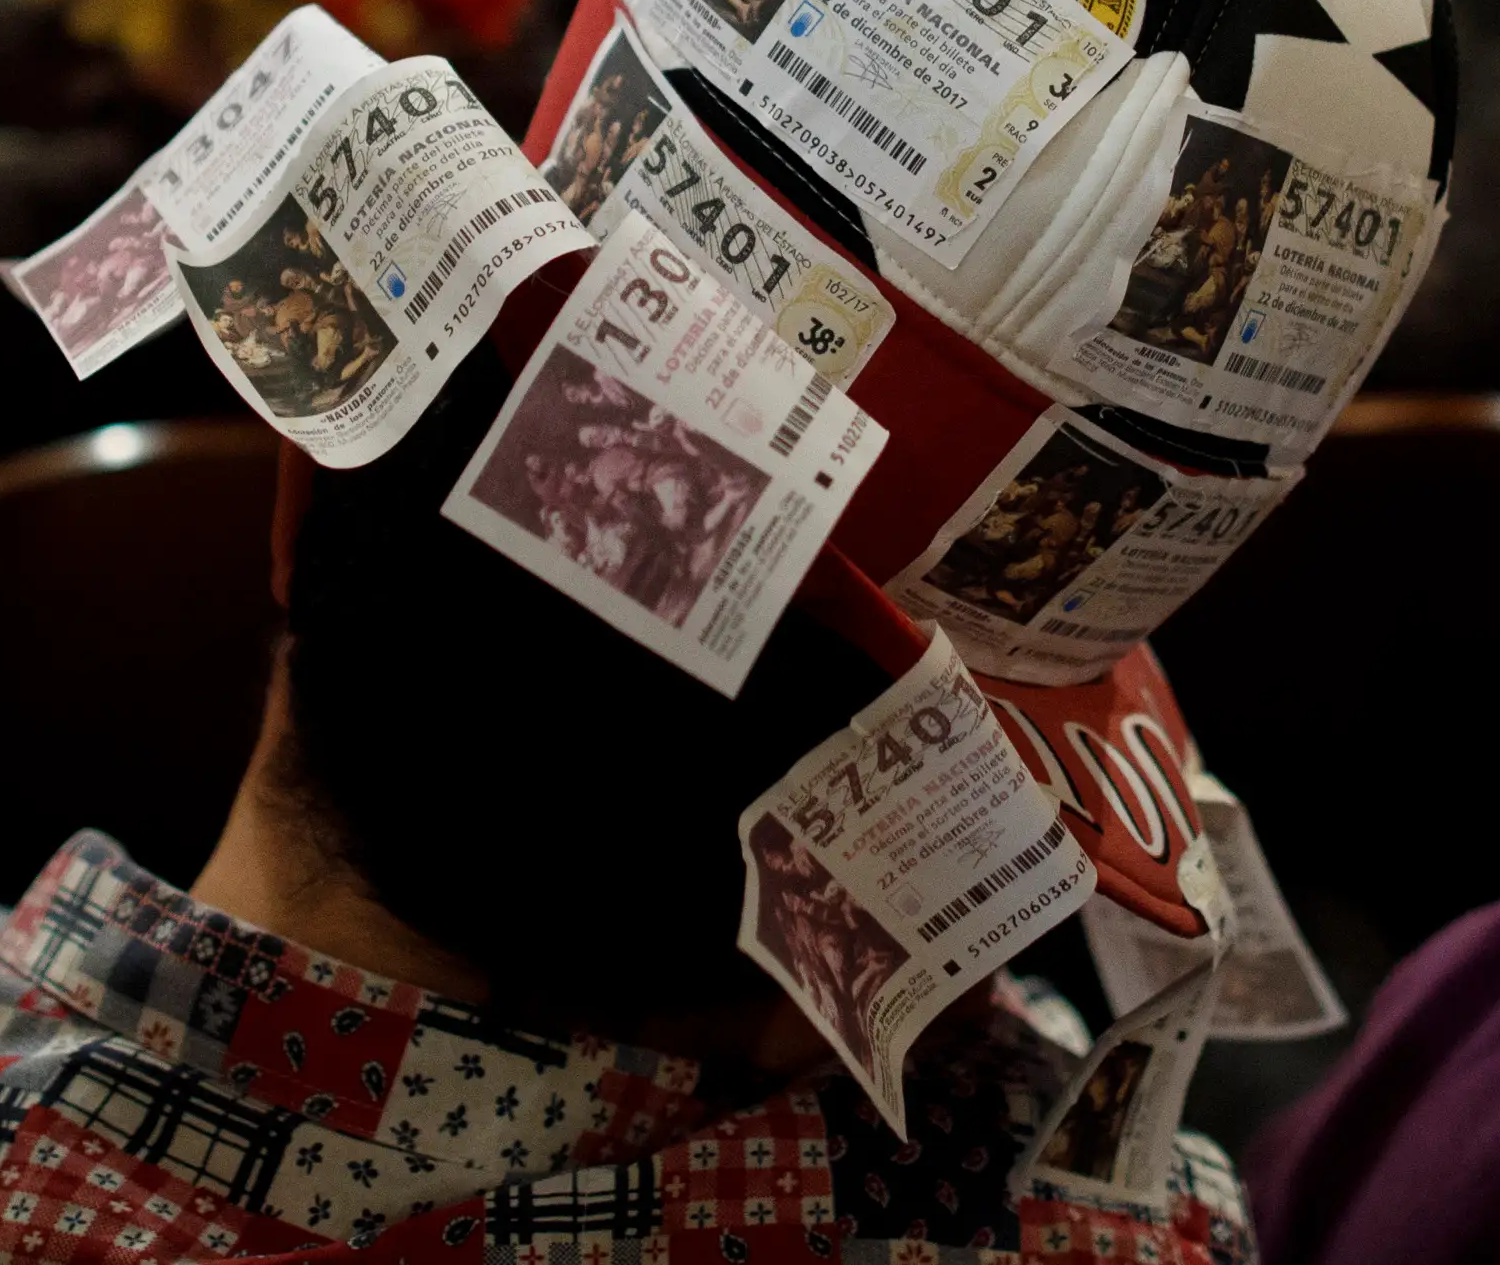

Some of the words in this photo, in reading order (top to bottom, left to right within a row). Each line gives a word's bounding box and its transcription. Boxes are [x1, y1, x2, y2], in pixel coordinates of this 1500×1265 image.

[832, 1, 850, 21] de
[850, 15, 913, 70] diciembre
[913, 65, 932, 85] de
[932, 80, 968, 111] 2017
[882, 16, 918, 51] sorteo
[919, 44, 940, 68] del
[939, 57, 958, 80] día
[917, 2, 1002, 77] NACIONAL
[918, 23, 939, 50] del
[938, 37, 976, 76] billete
[965, 6, 985, 25] CERO
[1002, 39, 1020, 56] UNO
[158, 33, 293, 188] 13047
[377, 131, 406, 156] CUATRO
[307, 80, 477, 222] 57401
[343, 166, 397, 242] LOTERÍA
[398, 118, 493, 165] NACIONAL
[361, 195, 394, 235] Décima
[392, 162, 419, 193] parte
[422, 146, 442, 163] del
[442, 129, 486, 149] billete
[376, 213, 397, 239] para
[403, 164, 438, 197] sorteo
[439, 148, 460, 165] del
[462, 139, 484, 153] día
[759, 95, 947, 248] 5102709038>057401497
[369, 250, 387, 272] 22
[384, 231, 400, 252] de
[398, 170, 455, 232] diciembre
[456, 156, 476, 172] de
[480, 146, 514, 162] 2017
[642, 132, 791, 295] 57401
[755, 219, 774, 237] DEL
[771, 231, 812, 269] ESTADO
[1279, 179, 1401, 256] 57401
[715, 257, 733, 274] CERO
[825, 278, 870, 313] 102/17
[1273, 244, 1324, 272] LOTERÍA
[1278, 283, 1298, 298] para
[656, 306, 718, 385] LOTERÍA
[1257, 291, 1271, 307] 22
[1271, 296, 1284, 311] de
[1284, 298, 1327, 325] diciembre
[705, 388, 726, 411] 22
[721, 370, 739, 389] de
[706, 352, 727, 376] para
[1142, 502, 1258, 540] 57401
[792, 674, 985, 843] 57401
[843, 794, 922, 862] LOTERÍA
[869, 820, 916, 856] Décima
[916, 794, 948, 823] parte
[950, 778, 970, 797] del
[971, 748, 1009, 783] billete
[877, 871, 898, 890] 22
[898, 856, 918, 875] de
[918, 804, 990, 860] diciembre
[989, 789, 1010, 808] de
[888, 839, 917, 862] para
[930, 798, 969, 831] sorteo
[970, 781, 992, 801] del
[991, 765, 1010, 785] día
